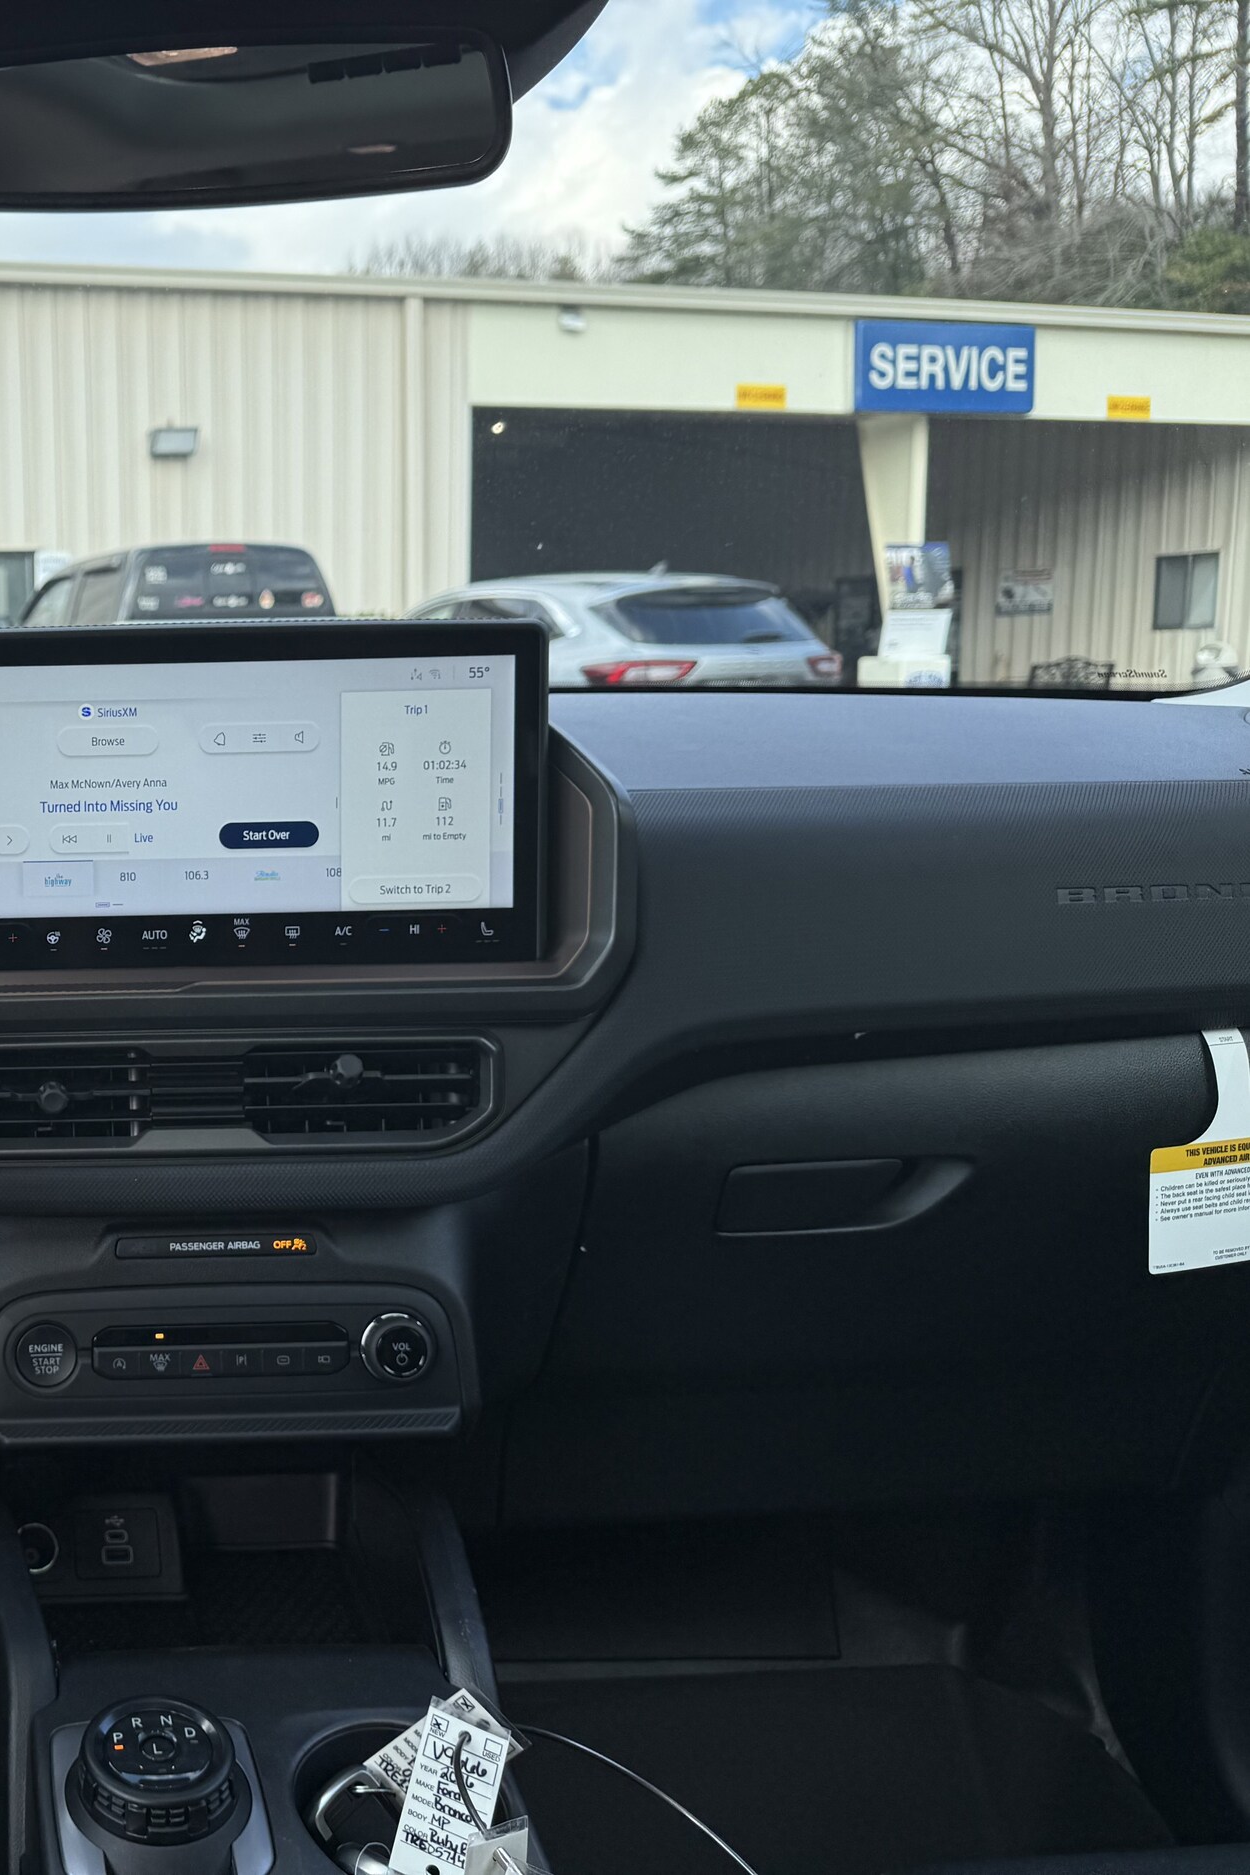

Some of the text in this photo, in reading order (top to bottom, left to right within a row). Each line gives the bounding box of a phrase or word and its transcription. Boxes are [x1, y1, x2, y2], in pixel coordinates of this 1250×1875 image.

[868, 342, 1028, 392] SERVICE
[469, 667, 490, 679] 55°
[97, 707, 138, 718] SiriusXM
[404, 704, 428, 716] Trip 1
[91, 736, 125, 746] Browse
[377, 761, 397, 771] 14.9
[423, 760, 466, 770] 01:02:34
[50, 778, 167, 789] Max McNown/Avery Anna
[378, 778, 395, 786] MPG
[436, 776, 454, 784] Time
[40, 799, 178, 813] Turned Into Missing You
[377, 818, 397, 828] 11.7
[436, 816, 454, 826] 112
[134, 833, 153, 843] Live
[243, 830, 290, 841] Start Over
[442, 832, 466, 841] Empty
[120, 872, 136, 882] 810
[184, 871, 209, 880] 106.3
[44, 877, 72, 887] highway
[380, 884, 451, 895] Switch to Trip 2
[335, 926, 352, 936] A/C
[409, 924, 420, 934] HI
[142, 930, 168, 940] AUTO
[1186, 1148, 1200, 1157] THIS
[1202, 1145, 1228, 1155] VEHICLE
[1230, 1144, 1236, 1152] IS
[1203, 1153, 1250, 1166] ADVANCED AIR
[1210, 1170, 1223, 1178] WITH
[1224, 1167, 1250, 1176] ADVANCED
[1160, 1184, 1184, 1192] Children
[1227, 1176, 1250, 1184] seriously
[1215, 1185, 1230, 1193] safest
[1232, 1184, 1245, 1192] place
[170, 1240, 291, 1251] PASSENGER AIRBAG OFF
[28, 1344, 64, 1353] ENGINE
[392, 1342, 411, 1350] VOL
[32, 1357, 61, 1366] START
[150, 1354, 171, 1362] MAX
[35, 1366, 59, 1374] STOP
[113, 1715, 196, 1743] P R N D
[430, 1727, 446, 1738] NEW
[153, 1743, 162, 1755] L
[482, 1750, 500, 1762] USED
[420, 1763, 438, 1776] YEAR
[416, 1778, 435, 1792] MAKE
[412, 1793, 435, 1809] MODEL
[408, 1809, 427, 1821] BODY
[431, 1814, 450, 1830] MP
[404, 1824, 428, 1838] COLOR
